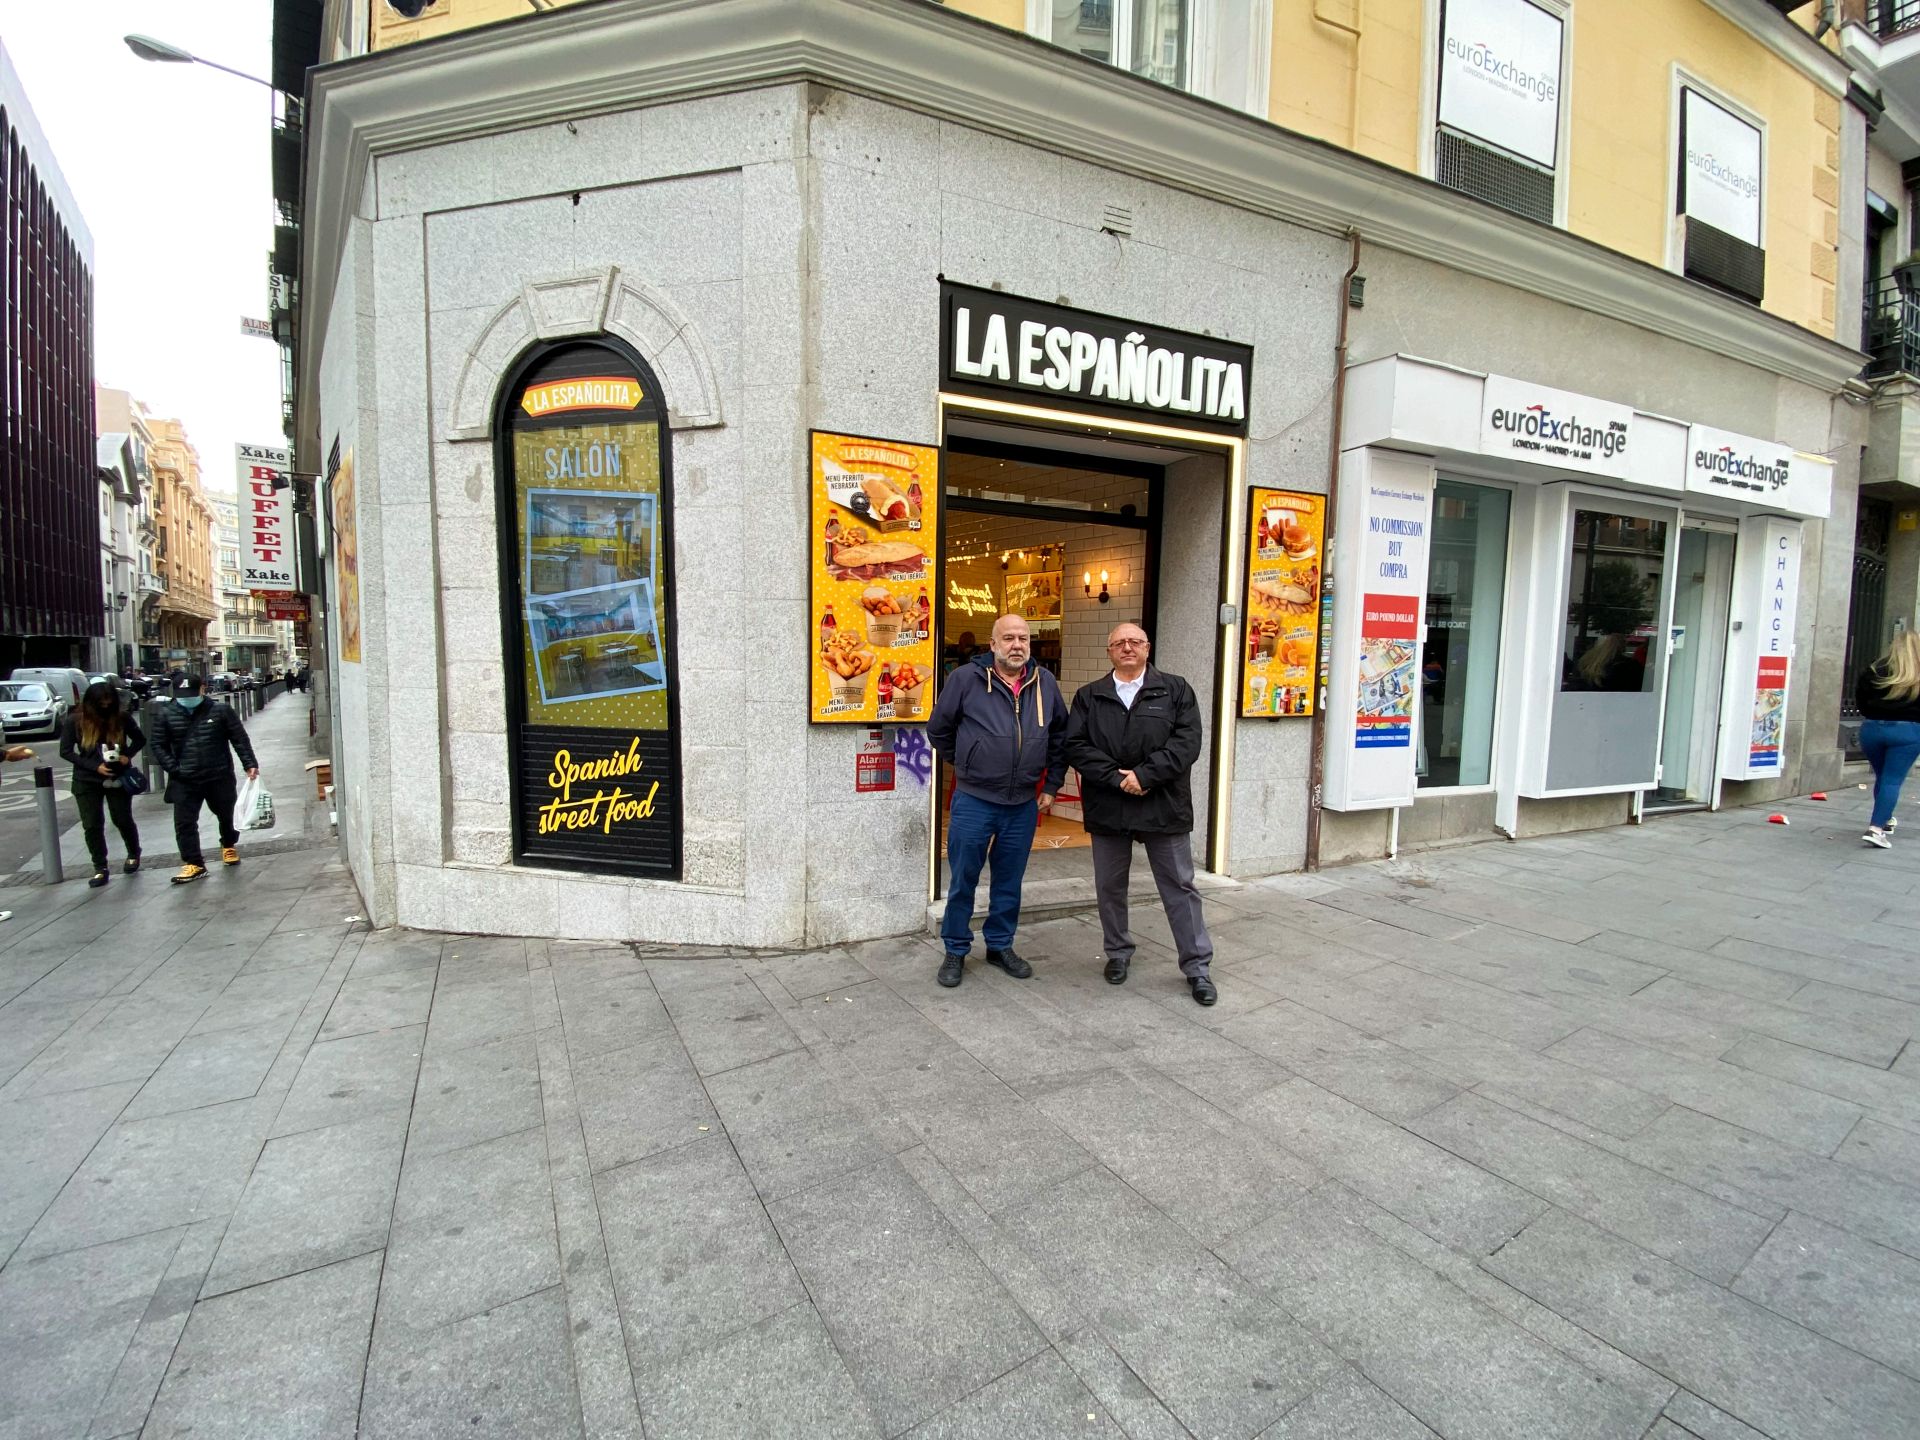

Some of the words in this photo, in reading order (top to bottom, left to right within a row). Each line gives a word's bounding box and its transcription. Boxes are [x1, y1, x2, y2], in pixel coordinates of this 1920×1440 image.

[1447, 37, 1555, 102] euroExchange
[1688, 150, 1757, 198] euroExchange
[243, 318, 272, 331] ALIS
[956, 307, 1011, 381] LA
[1018, 320, 1245, 420] ESPAÑOLITA
[533, 392, 549, 411] LA
[552, 382, 629, 406] ESPAÑOLITA
[1492, 405, 1626, 458] euroExchange
[1512, 438, 1540, 450] LONDON
[240, 446, 284, 461] Xake
[545, 440, 621, 480] SALÓN
[845, 448, 855, 460] LA
[842, 474, 864, 482] PERRITO
[1695, 448, 1788, 490] euroExchange
[249, 465, 280, 562] BUFFET
[1370, 517, 1379, 532] NO
[1381, 518, 1424, 537] COMMISSION
[246, 568, 290, 581] Xake
[1380, 562, 1408, 579] COMPRA
[1771, 536, 1788, 651] CHANGE
[1366, 612, 1379, 621] EURO
[1380, 613, 1396, 622] POUND
[1396, 613, 1414, 622] DOLLAR
[821, 704, 852, 714] CALAMARES
[548, 736, 643, 801] Spanish
[539, 790, 604, 835] street
[604, 781, 659, 834] food
